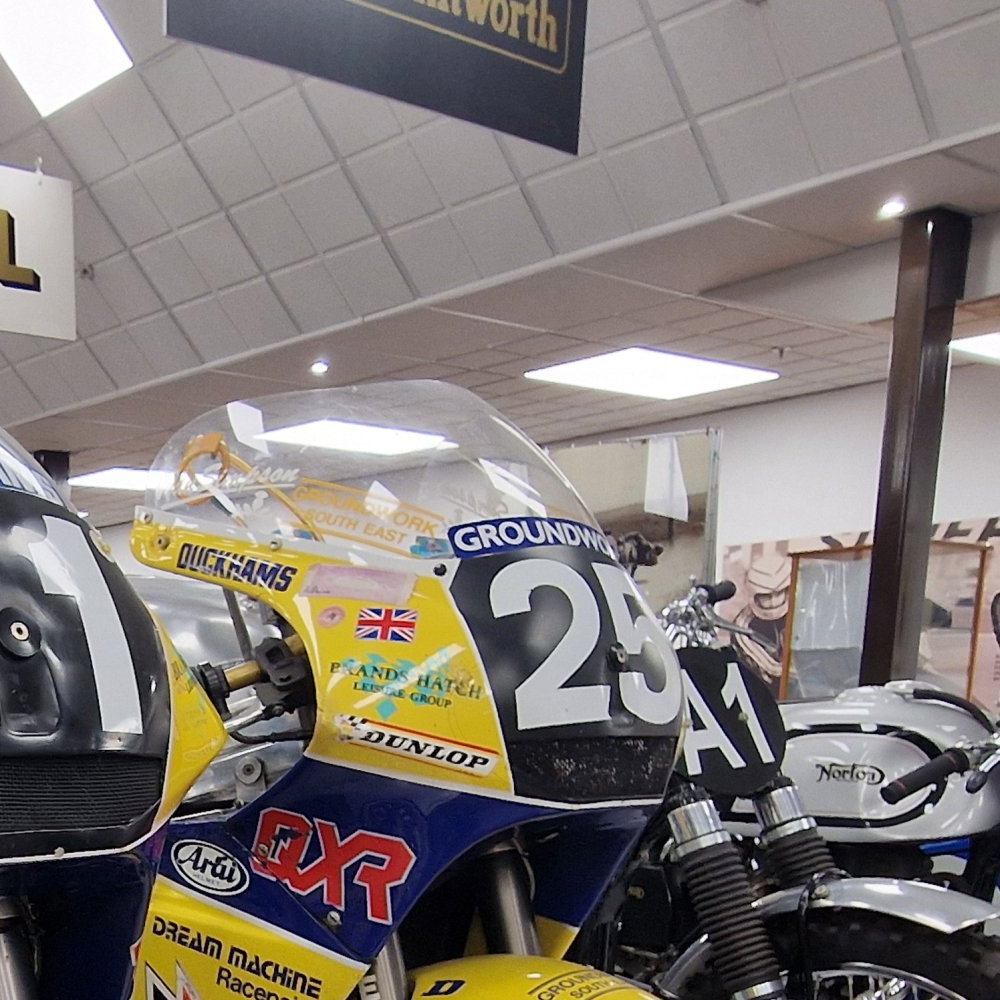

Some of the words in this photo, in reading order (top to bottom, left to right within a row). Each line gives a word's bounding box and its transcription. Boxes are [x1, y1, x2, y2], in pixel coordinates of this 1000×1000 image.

[413, 0, 557, 53] worth
[304, 507, 359, 532] SOUTH
[362, 519, 409, 544] EAST
[454, 520, 612, 557] GROUNDWO
[176, 542, 298, 592] DUCKHAMS
[489, 557, 684, 731] 25
[330, 661, 409, 685] BRANDS
[417, 671, 483, 700] HATCH
[409, 691, 453, 709] GROUP
[681, 662, 776, 776] A1
[360, 730, 490, 770] DUNLOP
[815, 762, 886, 785] Norton
[178, 846, 237, 883] Arai
[248, 807, 417, 926] QXR
[152, 915, 223, 960] DREAM
[227, 943, 322, 999] MACHINE
